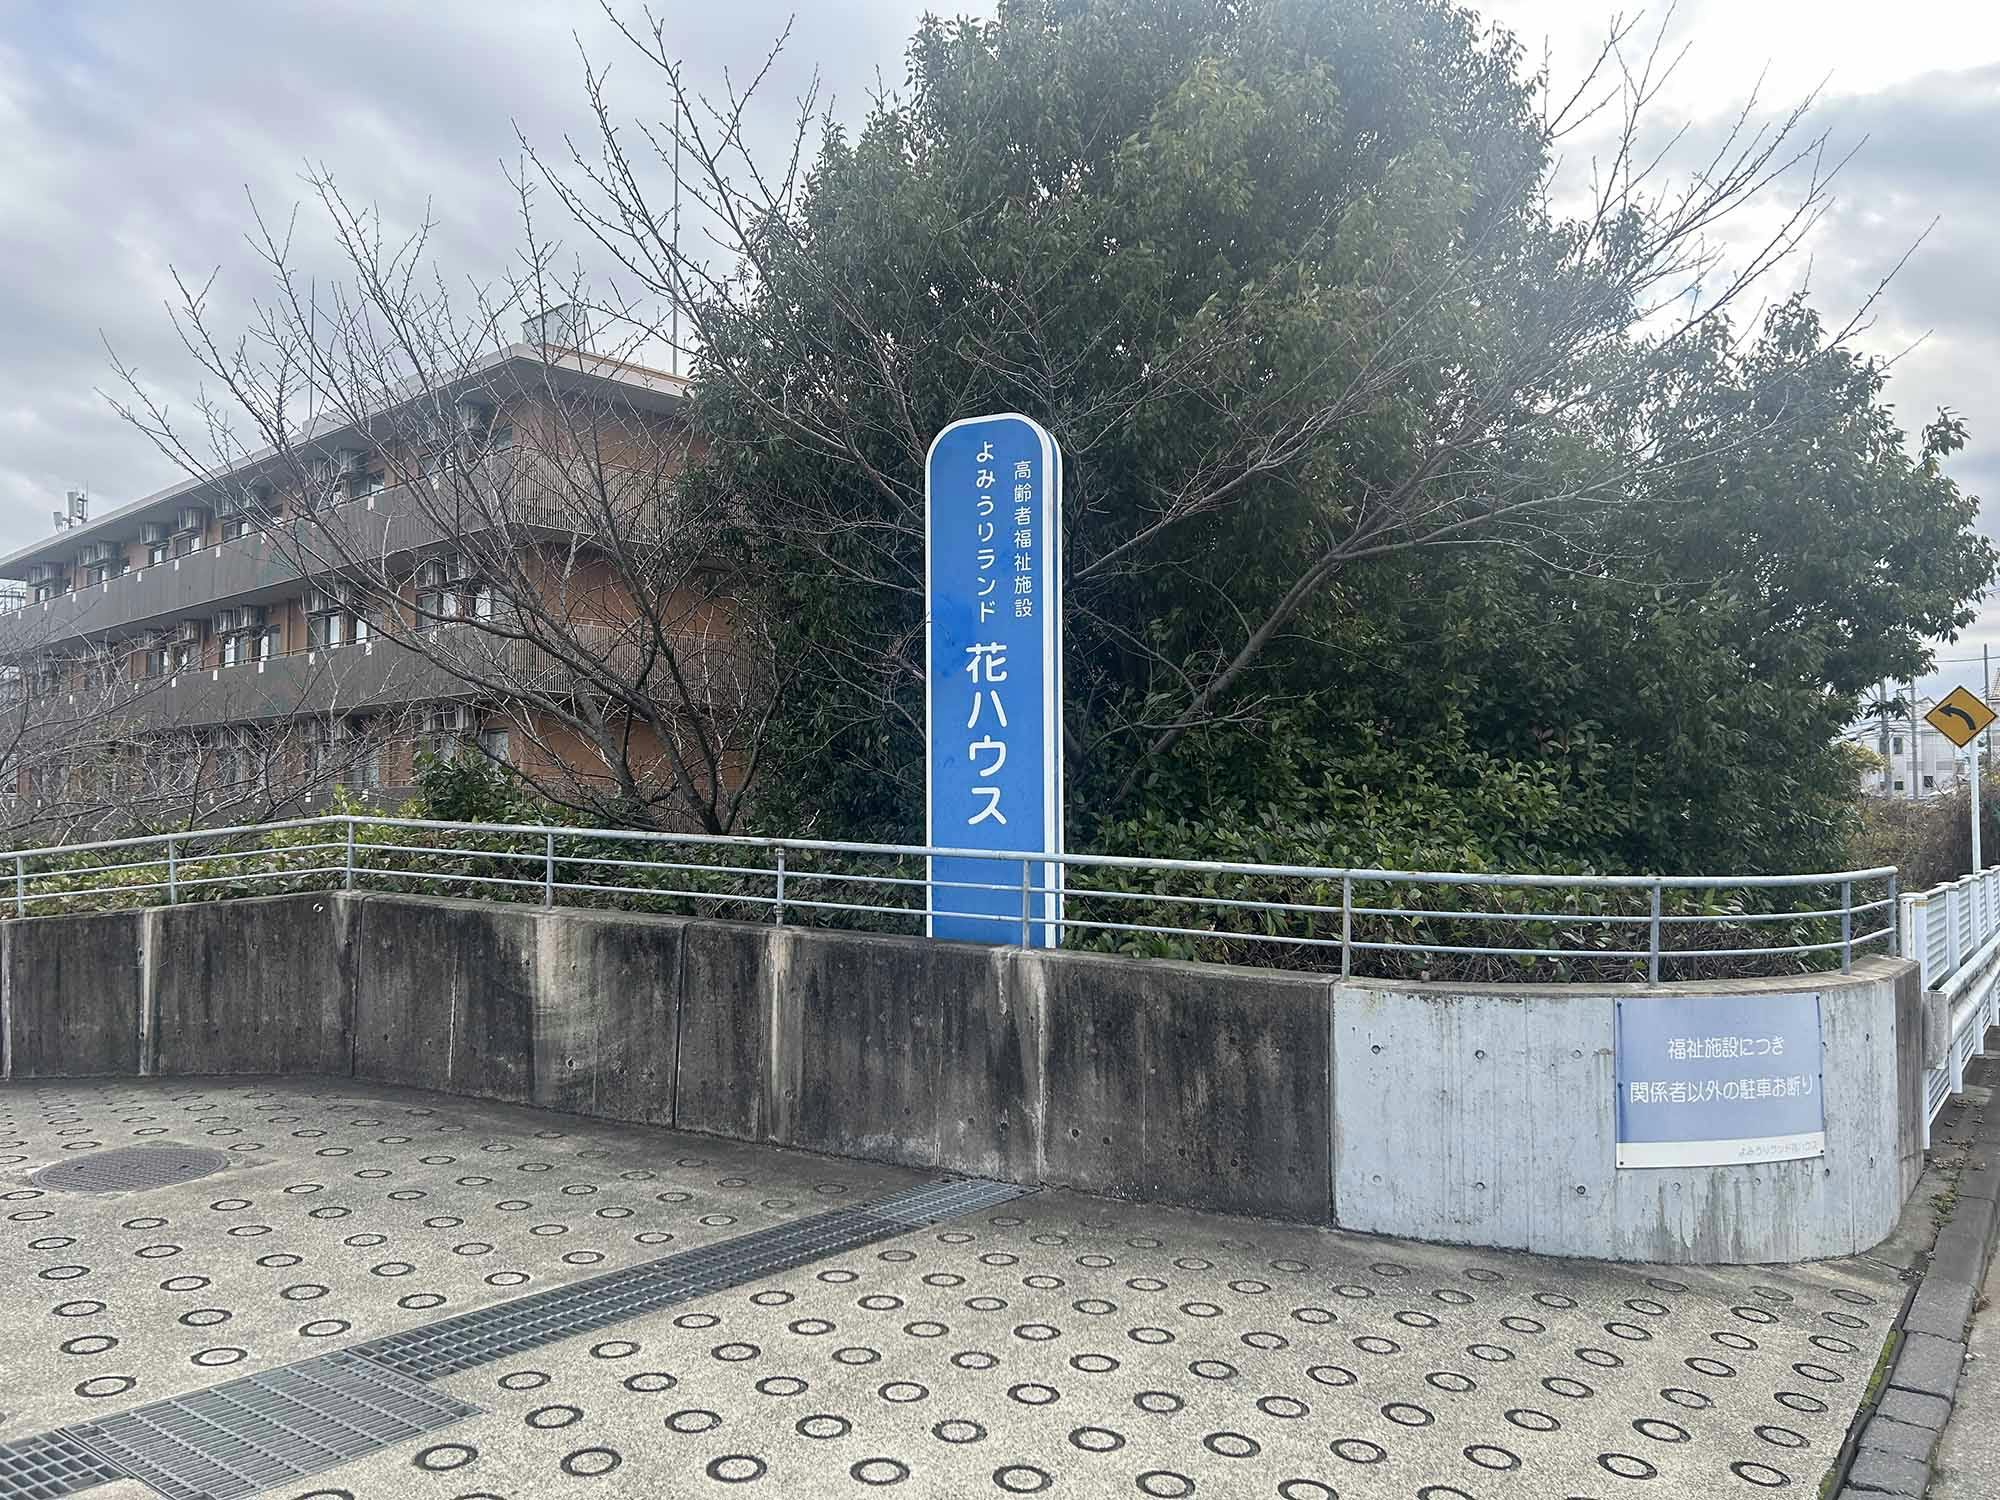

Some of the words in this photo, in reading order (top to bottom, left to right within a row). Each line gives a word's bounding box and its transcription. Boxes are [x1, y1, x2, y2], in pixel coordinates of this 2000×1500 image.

[976, 441, 996, 623] よみうりランド
[1014, 460, 1033, 618] 高齢者福祉施設
[966, 642, 1008, 825] 花ハウス
[1630, 1075, 1813, 1104] 関係者以外の駐車お断り
[1667, 1036, 1785, 1060] 福祉施設につき
